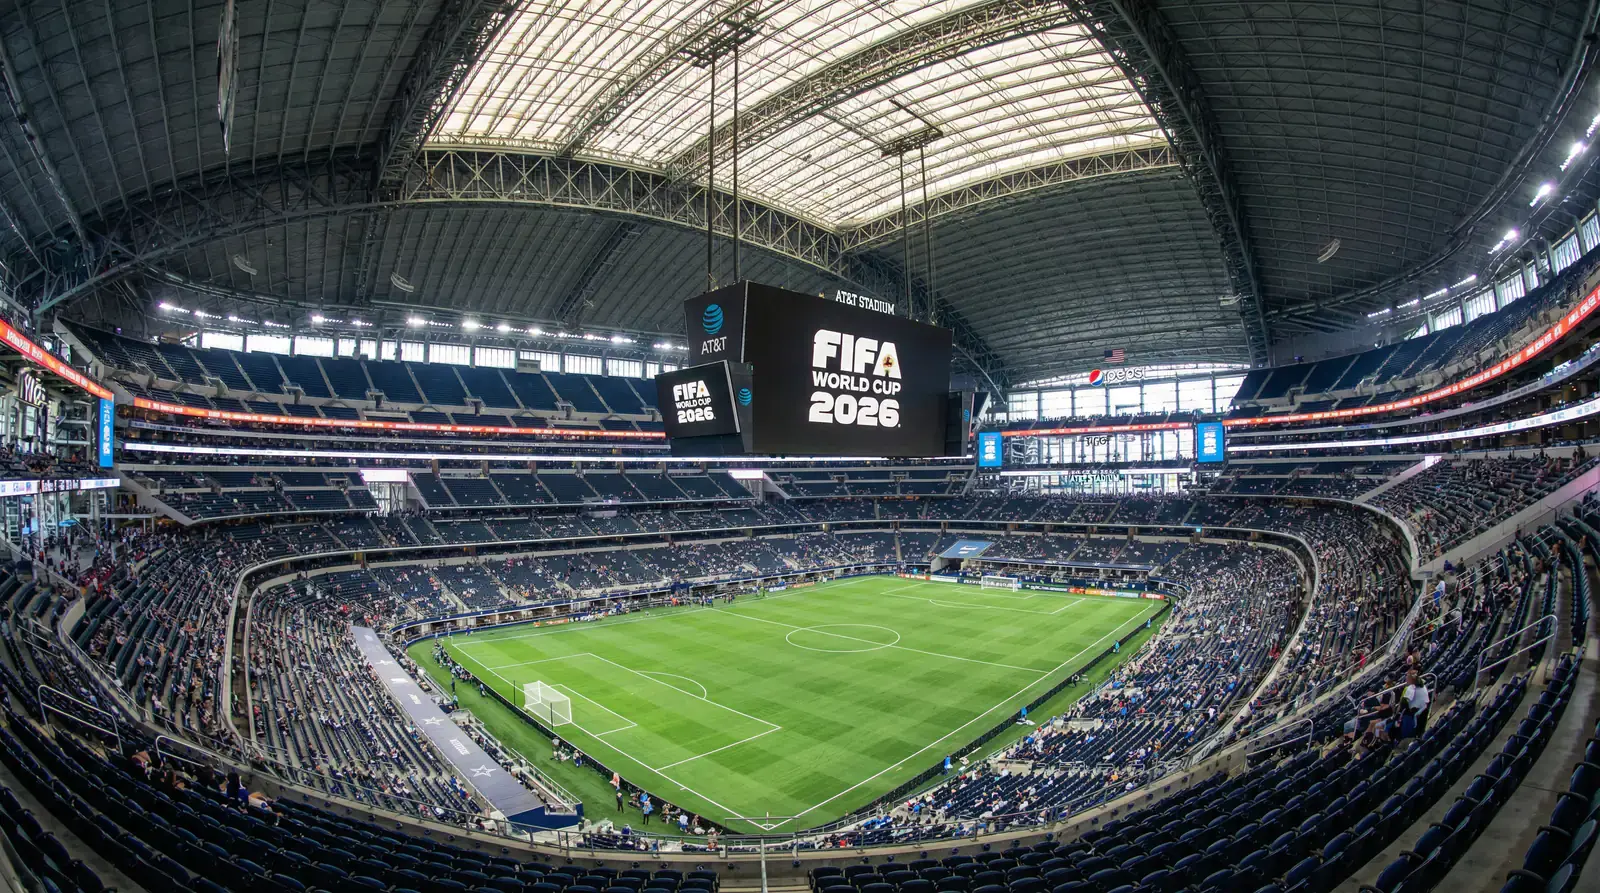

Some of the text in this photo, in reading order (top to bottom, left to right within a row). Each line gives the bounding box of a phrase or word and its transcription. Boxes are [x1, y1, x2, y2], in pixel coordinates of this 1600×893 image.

[836, 290, 895, 315] AT&T STADIUM
[701, 336, 727, 355] AT&T
[812, 329, 902, 379] FIFA
[673, 380, 710, 402] FIFA
[812, 370, 902, 396] WORLD CUP
[675, 397, 712, 409] WORLD CUP
[808, 391, 900, 427] 2026
[677, 406, 714, 424] 2026
